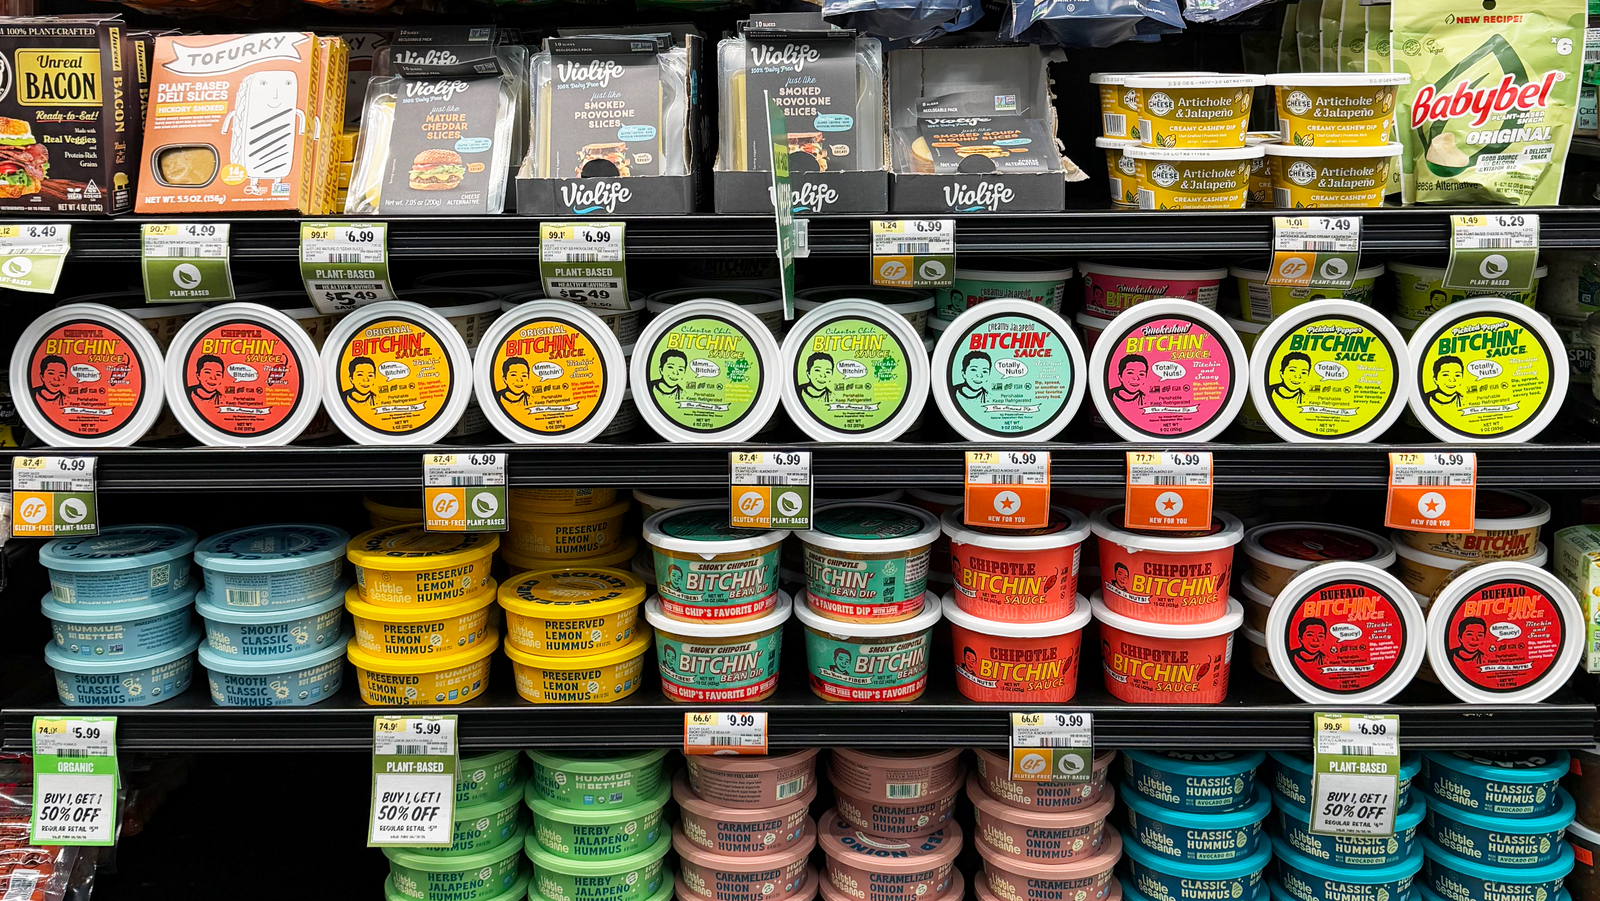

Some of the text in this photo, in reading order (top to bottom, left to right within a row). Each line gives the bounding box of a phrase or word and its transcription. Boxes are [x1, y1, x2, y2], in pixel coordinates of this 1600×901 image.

[6, 27, 96, 36] 100% PLANT-CRAFTED
[188, 35, 286, 66] TOFURKY
[37, 54, 83, 69] Unreal
[751, 44, 820, 71] Violife
[557, 60, 625, 87] Violife
[26, 72, 96, 100] BACON
[158, 81, 230, 91] PLANT-BASED
[406, 80, 469, 101] Violife
[779, 87, 821, 96] SMOKED
[157, 91, 228, 102] DELI SLICES
[1178, 96, 1232, 108] Artichoke
[1316, 96, 1372, 107] Artichoke
[1411, 71, 1557, 129] Babybel
[113, 76, 125, 133] BACON
[157, 104, 224, 112] HICKORY SMOKED
[584, 101, 625, 110] SMOKED
[36, 110, 99, 121] Ready-to-Eat!
[575, 110, 635, 119] PROVOLONE
[784, 107, 817, 116] SLICES
[1492, 111, 1545, 121] PLANT-BASED
[425, 114, 465, 122] MATURE
[589, 119, 621, 128] SLICES
[1517, 117, 1543, 125] SNACK
[421, 122, 468, 131] CHEDDAR
[67, 136, 96, 145] Veggies
[427, 131, 460, 139] SLICES
[1466, 127, 1552, 144] ORIGINAL
[228, 166, 245, 177] 14g
[1183, 168, 1236, 178] Artichoke
[1321, 167, 1374, 177] Artichoke
[1436, 180, 1478, 190] Alternative
[145, 196, 159, 204] NET
[192, 195, 203, 203] OZ.
[204, 195, 226, 203] (156g)
[561, 182, 632, 213] Violife
[943, 182, 1015, 212] Violife
[425, 199, 441, 207] (200g)
[914, 220, 942, 233] $6.99
[1320, 218, 1350, 230] $7.49
[1495, 215, 1524, 227] $6.29
[27, 225, 56, 238] $8.49
[186, 225, 215, 238] $4.99
[345, 230, 374, 243] $6.99
[583, 230, 611, 243] $6.99
[316, 268, 375, 279] PLANT-BASED
[555, 267, 613, 277] PLANT-BASED
[170, 289, 209, 297] PLANT-BASED
[366, 325, 413, 337] ORIGINAL
[520, 326, 566, 337] ORIGINAL
[1141, 322, 1191, 336] Smokeshow
[352, 333, 425, 356] BITCHIN'
[506, 333, 579, 357] BITCHIN'
[668, 334, 742, 350] BITCHIN'
[813, 334, 887, 352] BITCHIN'
[969, 332, 1051, 350] BITCHIN'
[1126, 333, 1208, 354] BITCHIN'
[1289, 334, 1376, 352] BITCHIN'
[1438, 328, 1522, 355] BITCHIN'
[46, 339, 120, 355] BITCHIN'
[202, 339, 279, 355] BITCHIN'
[1014, 349, 1052, 357] SAUCE
[1171, 350, 1210, 359] SAUCE
[1335, 353, 1375, 361] SAUCE
[88, 355, 124, 363] SAUCE
[997, 362, 1020, 370] Totally
[468, 455, 496, 466] $6.99
[773, 454, 800, 465] $6.99
[1008, 453, 1036, 465] $6.99
[1434, 454, 1463, 466] $6.99
[57, 459, 85, 471] $6.99
[727, 559, 758, 569] CHIPOTLE
[970, 557, 1036, 576] CHIPOTLE
[686, 566, 768, 592] BITCHIN'
[962, 569, 1047, 595] BITCHIN'
[729, 584, 768, 599] BEAN DIP
[1320, 588, 1365, 599] BUFFALO
[1481, 588, 1526, 599] BUFFALO
[1004, 594, 1046, 604] SAUCE
[685, 601, 765, 616] CHIP'S FAVORITE DIP
[1303, 596, 1381, 618] BITCHIN'
[1464, 596, 1541, 617] BITCHIN'
[1347, 611, 1385, 621] SAUCE
[545, 618, 605, 629] PRESERVED
[241, 624, 288, 635] SMOOTH
[546, 630, 582, 640] LEMON
[242, 635, 289, 645] CLASSIC
[546, 640, 594, 650] HUMMUS
[242, 644, 293, 655] HUMMUS
[727, 715, 754, 726] $9.99
[1055, 715, 1083, 727] $9.99
[72, 727, 100, 739] $5.99
[413, 723, 441, 734] $5.99
[1358, 723, 1386, 735] $6.99
[58, 762, 94, 772] ORGANIC
[387, 762, 444, 773] PLANT-BASED
[1329, 761, 1387, 773] PLANT-BASED
[1186, 777, 1231, 787] CLASSIC
[1186, 786, 1233, 796] HUMMUS
[44, 793, 66, 804] BUY
[75, 794, 95, 805] GET
[1327, 792, 1382, 804] BUY GET
[40, 807, 101, 823] 50% OFF
[1323, 805, 1386, 820] 50% OFF
[573, 826, 610, 835] HERBY
[717, 820, 782, 832] CARAMELIZED
[574, 830, 629, 845] JALAPEÑO
[717, 833, 750, 842] ONION
[574, 844, 621, 855] HUMMUS
[718, 842, 765, 852] HUMMUS
